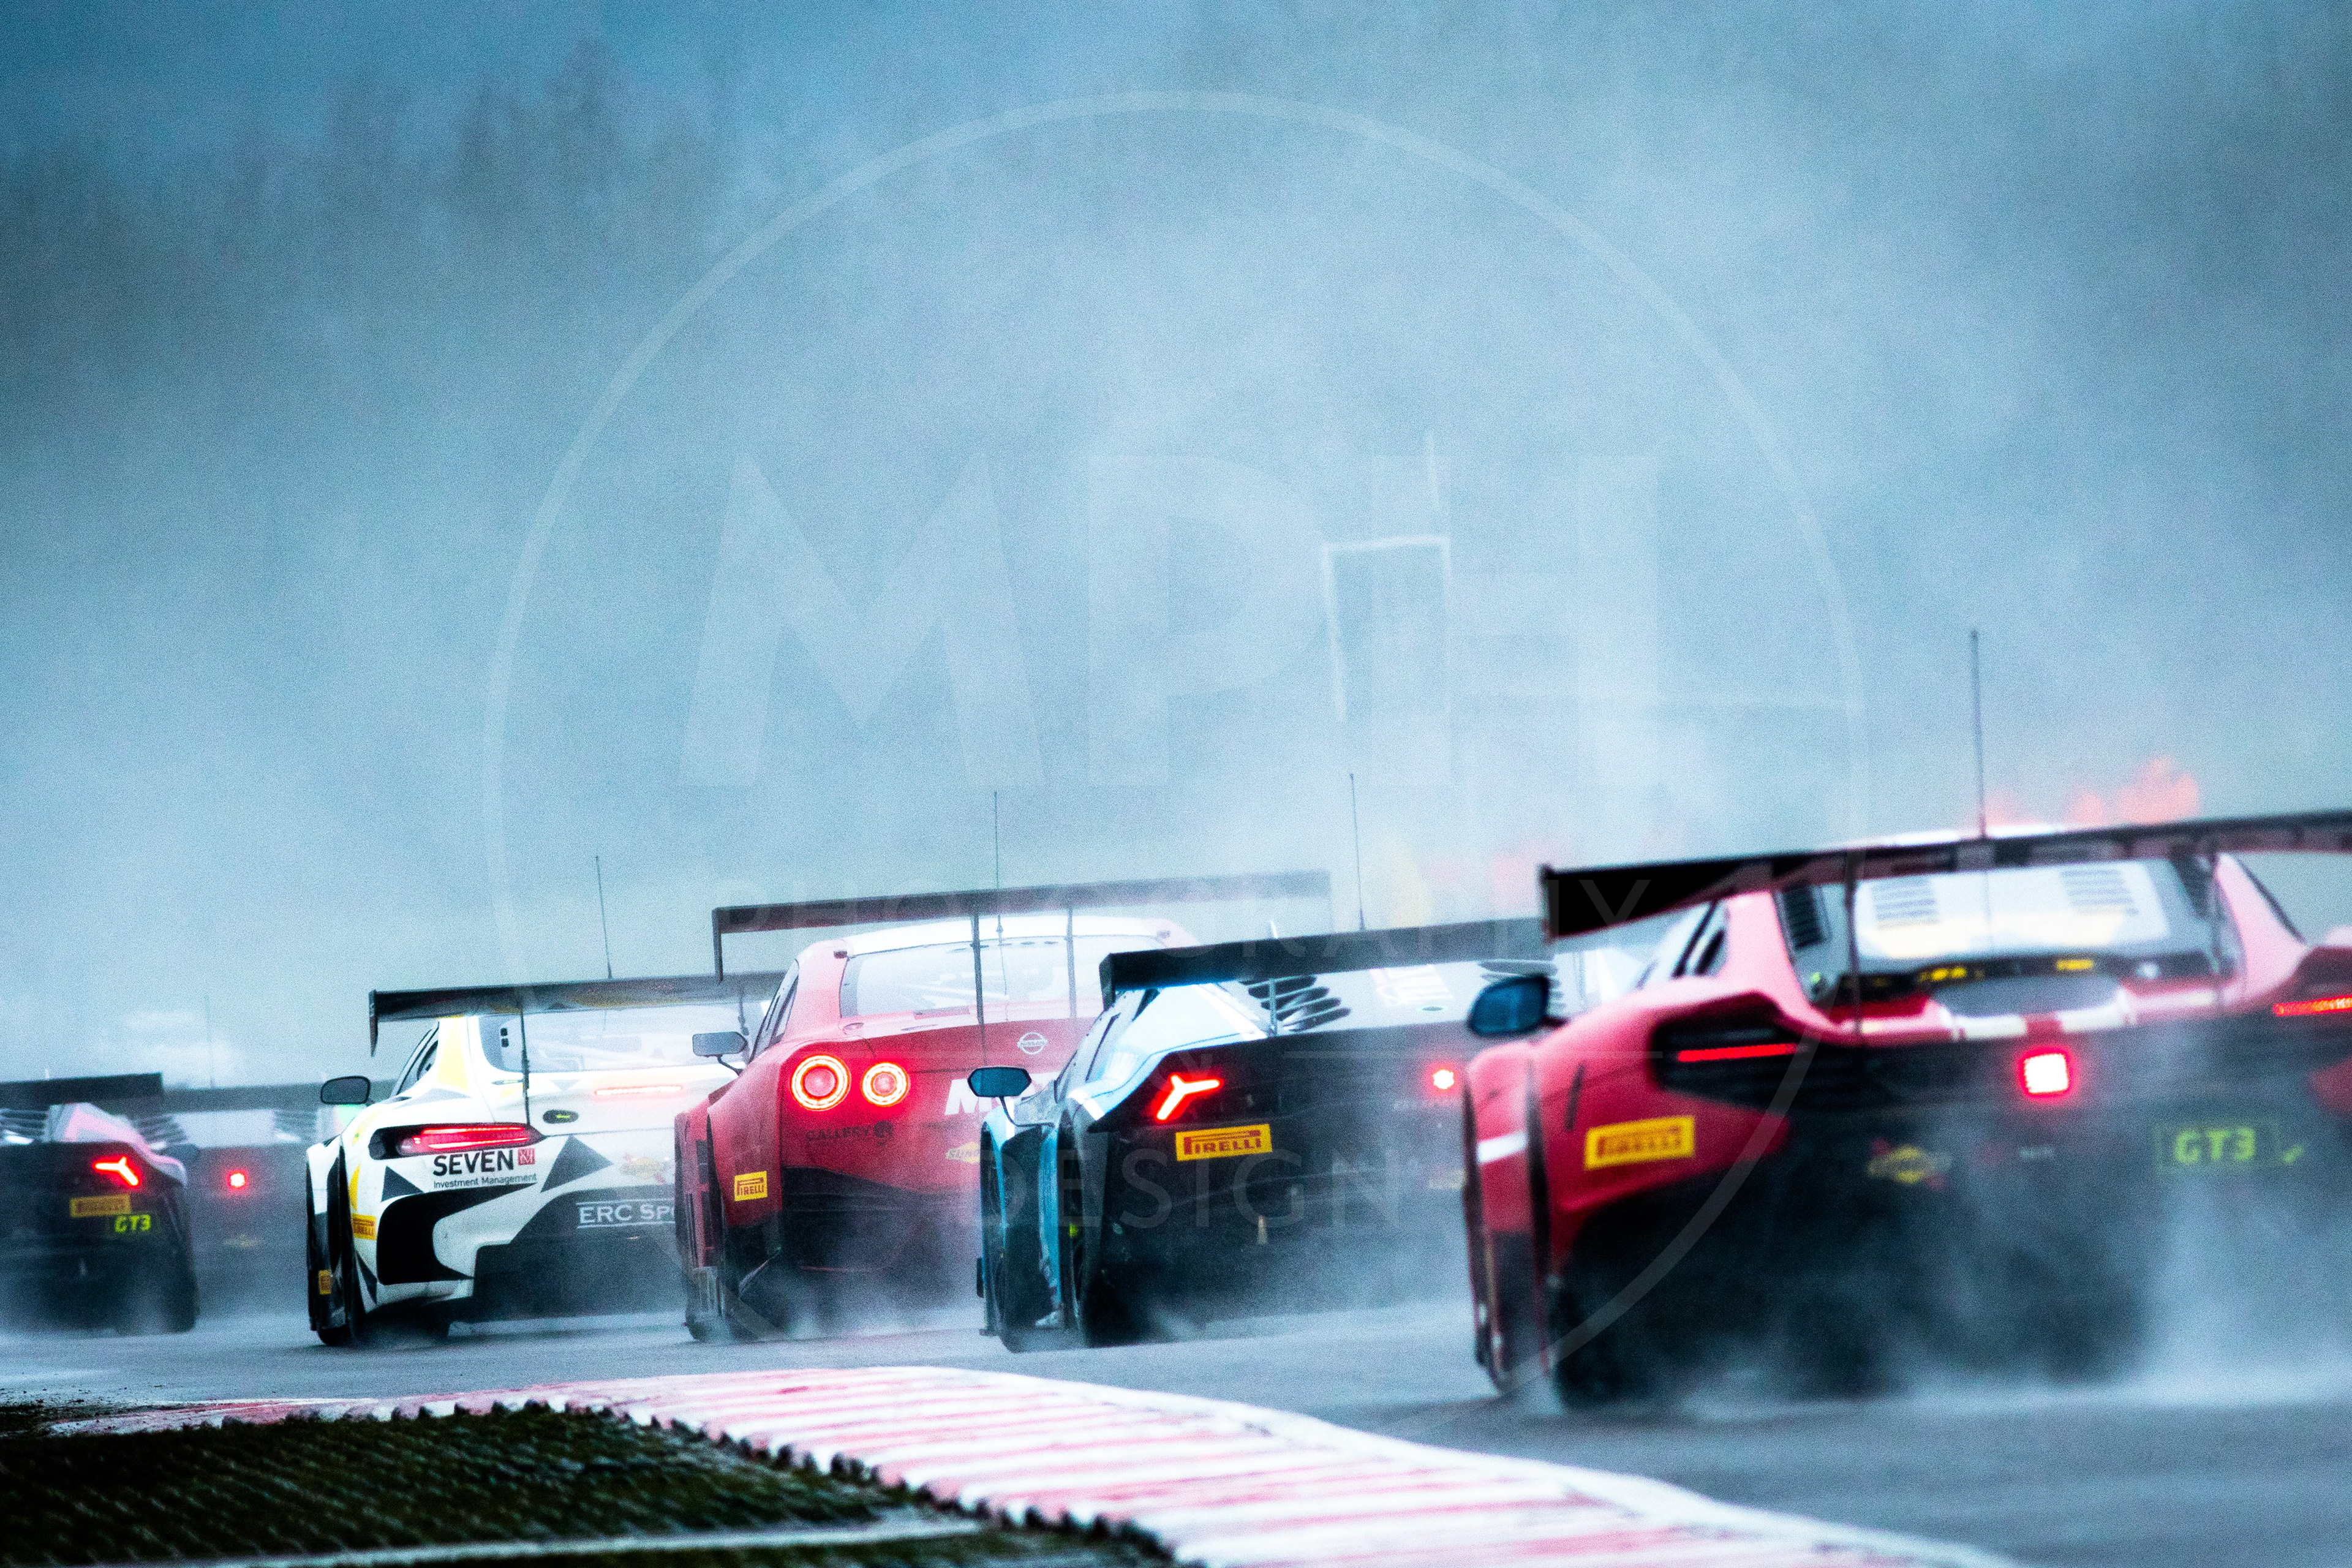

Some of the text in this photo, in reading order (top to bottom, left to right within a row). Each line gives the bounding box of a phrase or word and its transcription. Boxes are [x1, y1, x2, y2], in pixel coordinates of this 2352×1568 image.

[1183, 1129, 1262, 1155] PIRELLI
[2175, 1128, 2256, 1163] GT3
[432, 1149, 514, 1176] SEVEN
[434, 1177, 478, 1188] Investment
[481, 1174, 537, 1185] Management
[736, 1177, 764, 1196] PIRELLI
[579, 1204, 631, 1223] ERC
[115, 1214, 151, 1233] GT3
